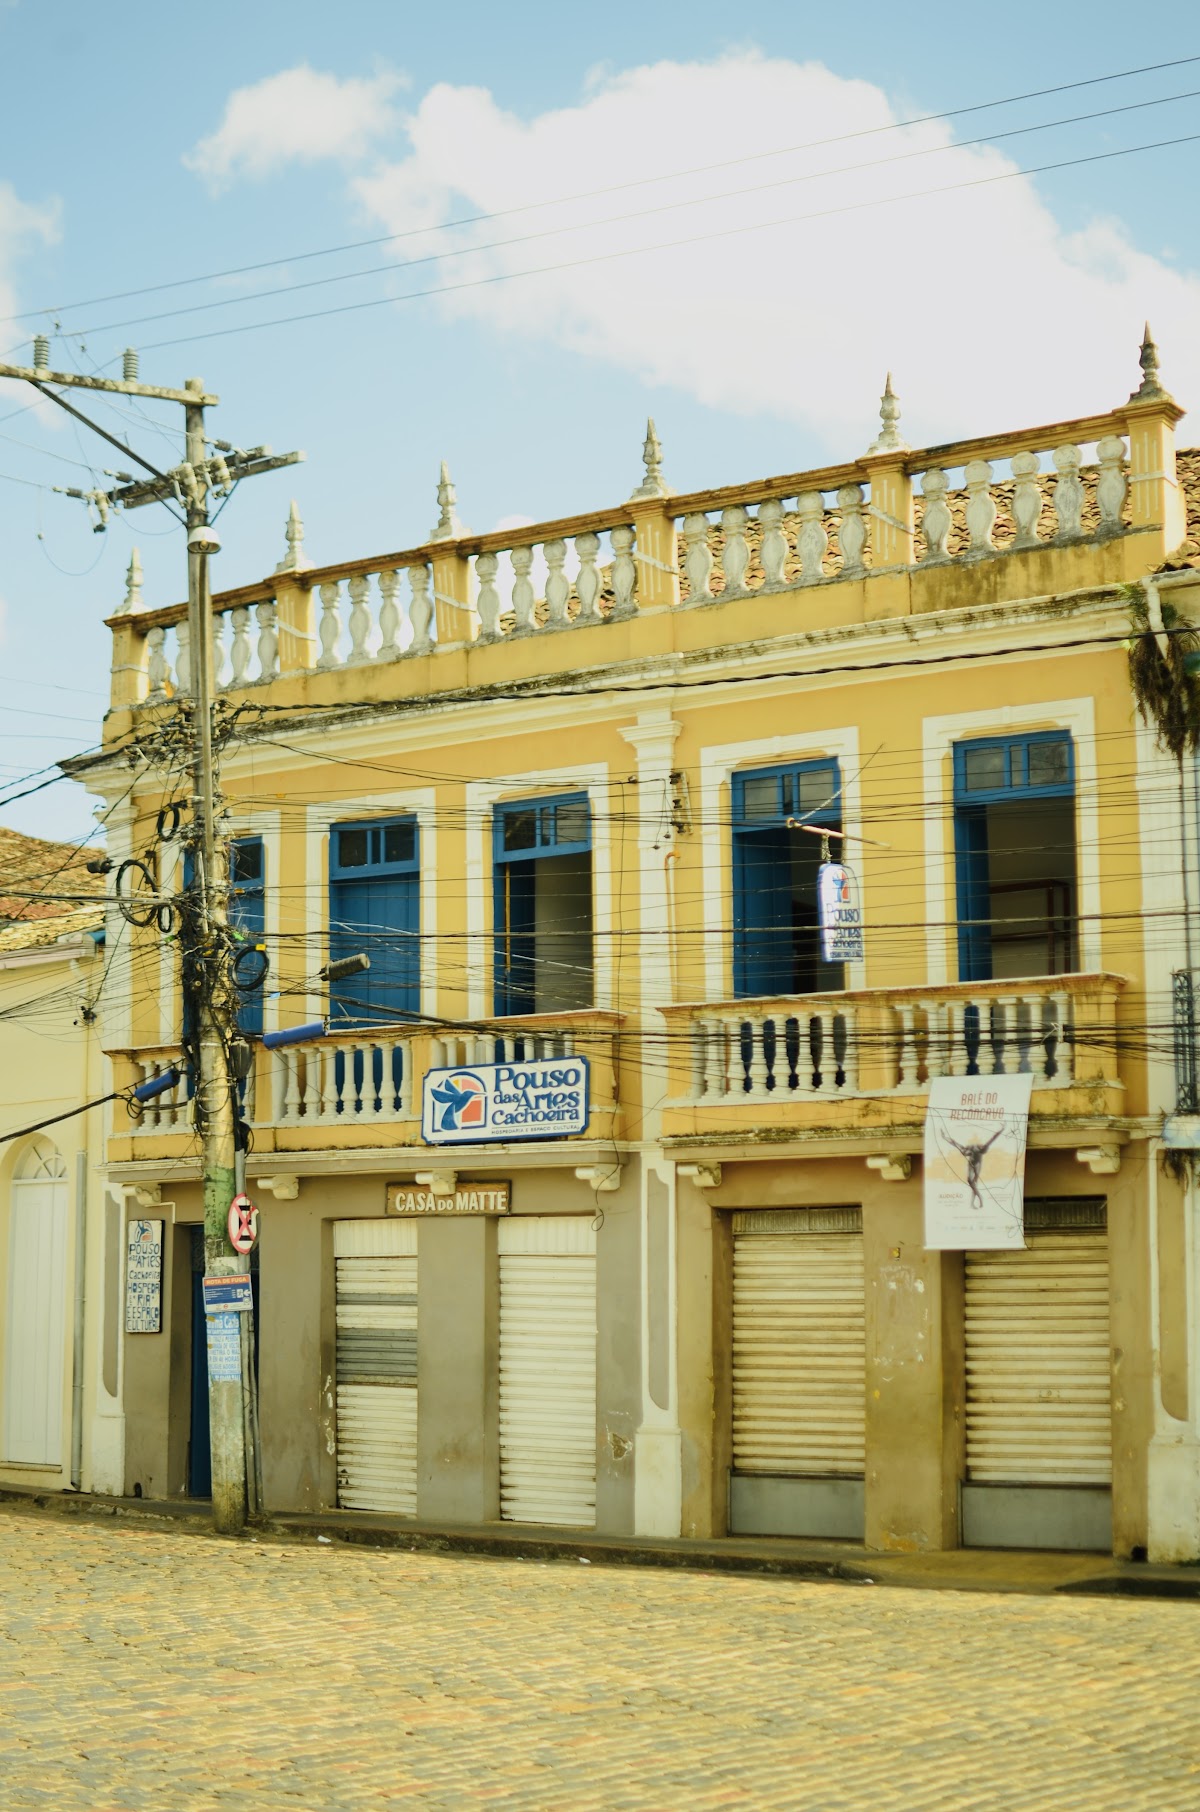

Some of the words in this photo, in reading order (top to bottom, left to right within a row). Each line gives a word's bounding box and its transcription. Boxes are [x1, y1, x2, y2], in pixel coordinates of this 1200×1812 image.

[826, 903, 860, 922] Pouso
[494, 1067, 581, 1092] Pouso
[493, 1091, 520, 1105] das
[514, 1090, 580, 1111] Artes
[961, 1091, 983, 1106] BALÉ
[985, 1092, 998, 1105] DO
[491, 1105, 581, 1126] Cachoeira
[395, 1192, 436, 1211] CASA
[437, 1199, 454, 1210] DO
[455, 1191, 507, 1211] MATTE
